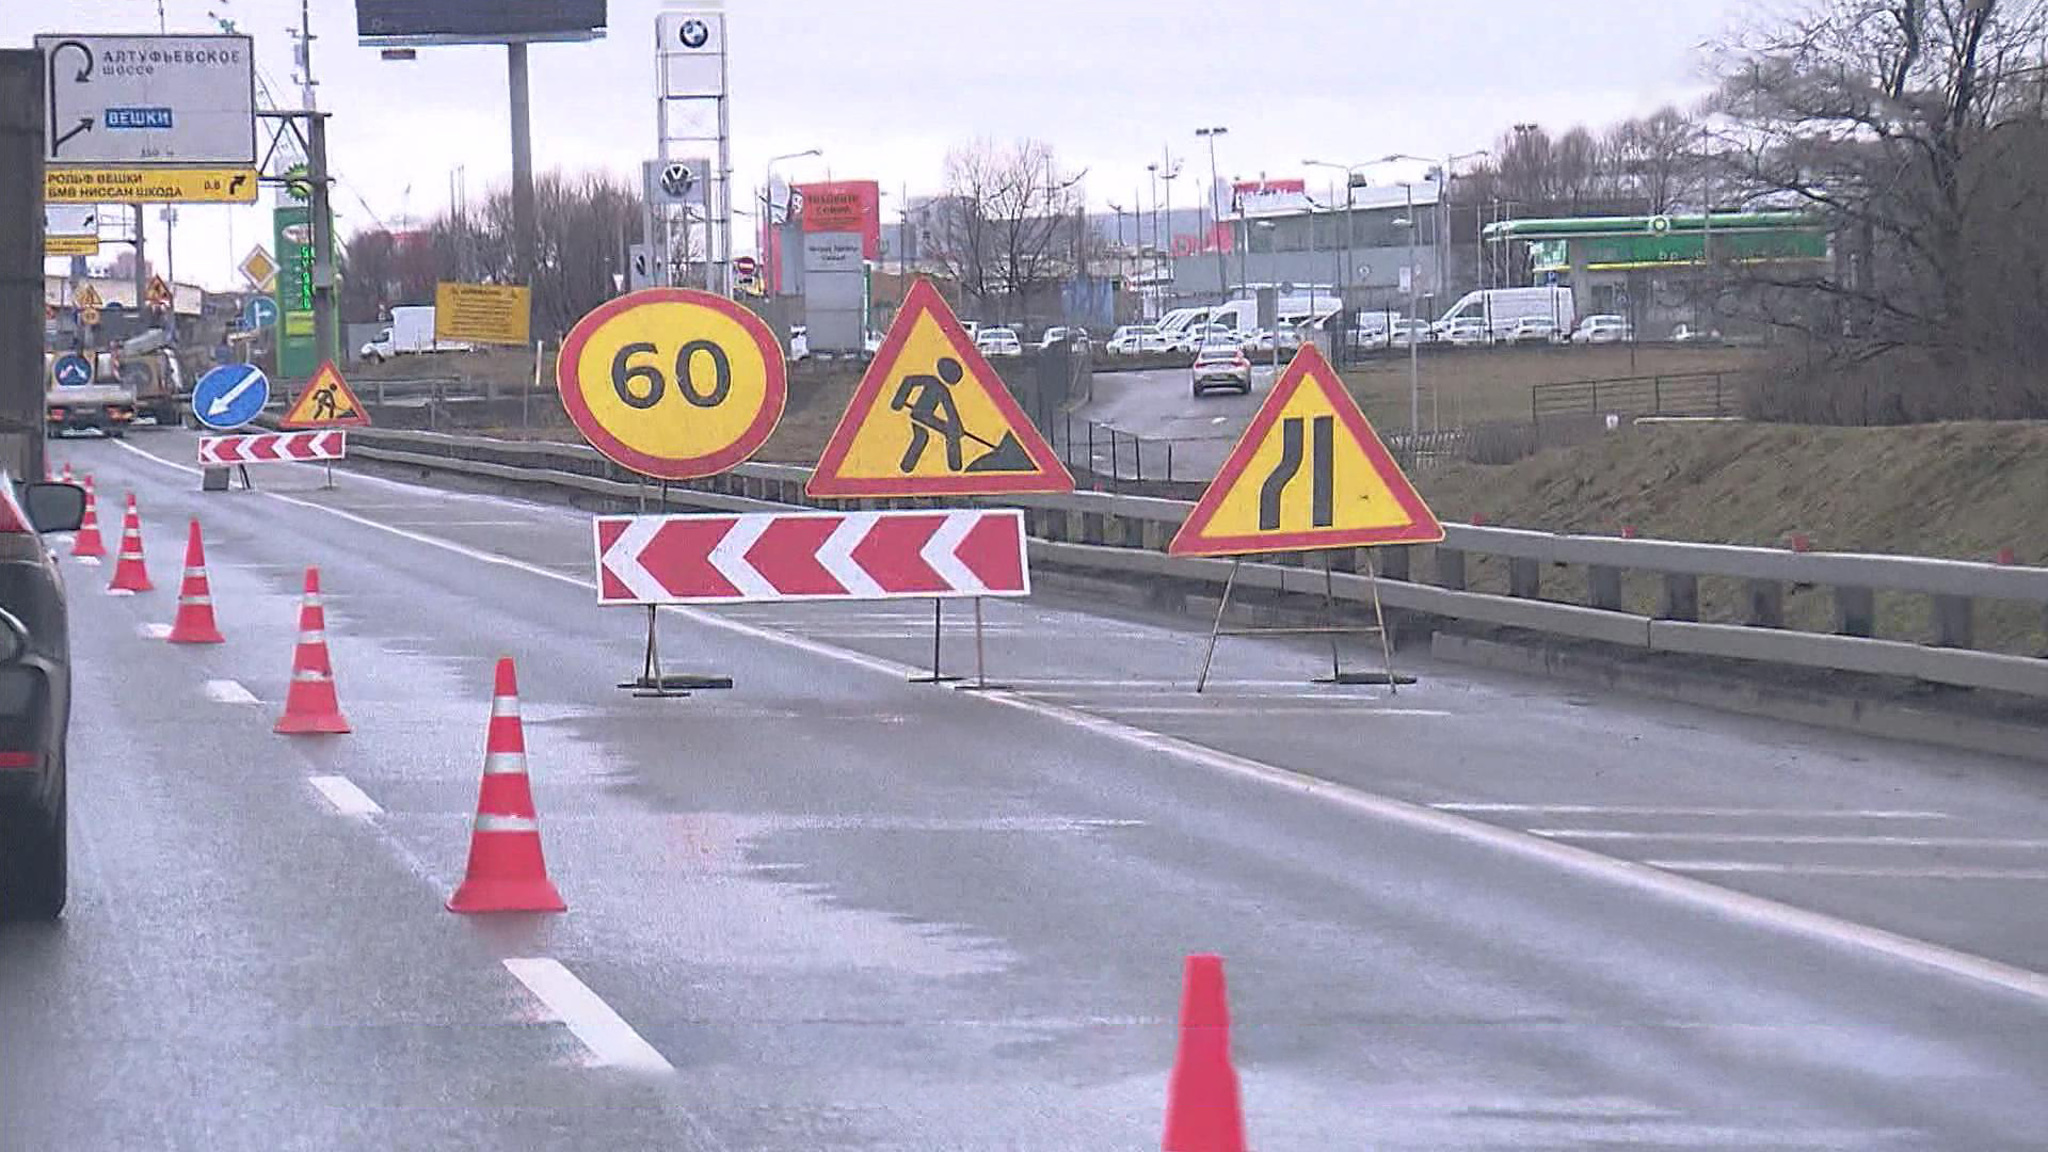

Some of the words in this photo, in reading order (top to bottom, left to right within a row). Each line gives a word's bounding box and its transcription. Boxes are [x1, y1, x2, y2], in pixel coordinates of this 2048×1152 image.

[103, 50, 240, 63] АЛТУФЬЕВСКОЕ
[102, 65, 154, 75] шоссе
[108, 111, 170, 125] ВЕШКИ
[48, 173, 94, 184] РОЛЬФ
[97, 173, 143, 183] ВЕШКИ
[49, 187, 76, 197] БМВ
[80, 186, 133, 197] НИССАН
[135, 186, 182, 198] ШКОДА
[611, 339, 731, 409] 60
